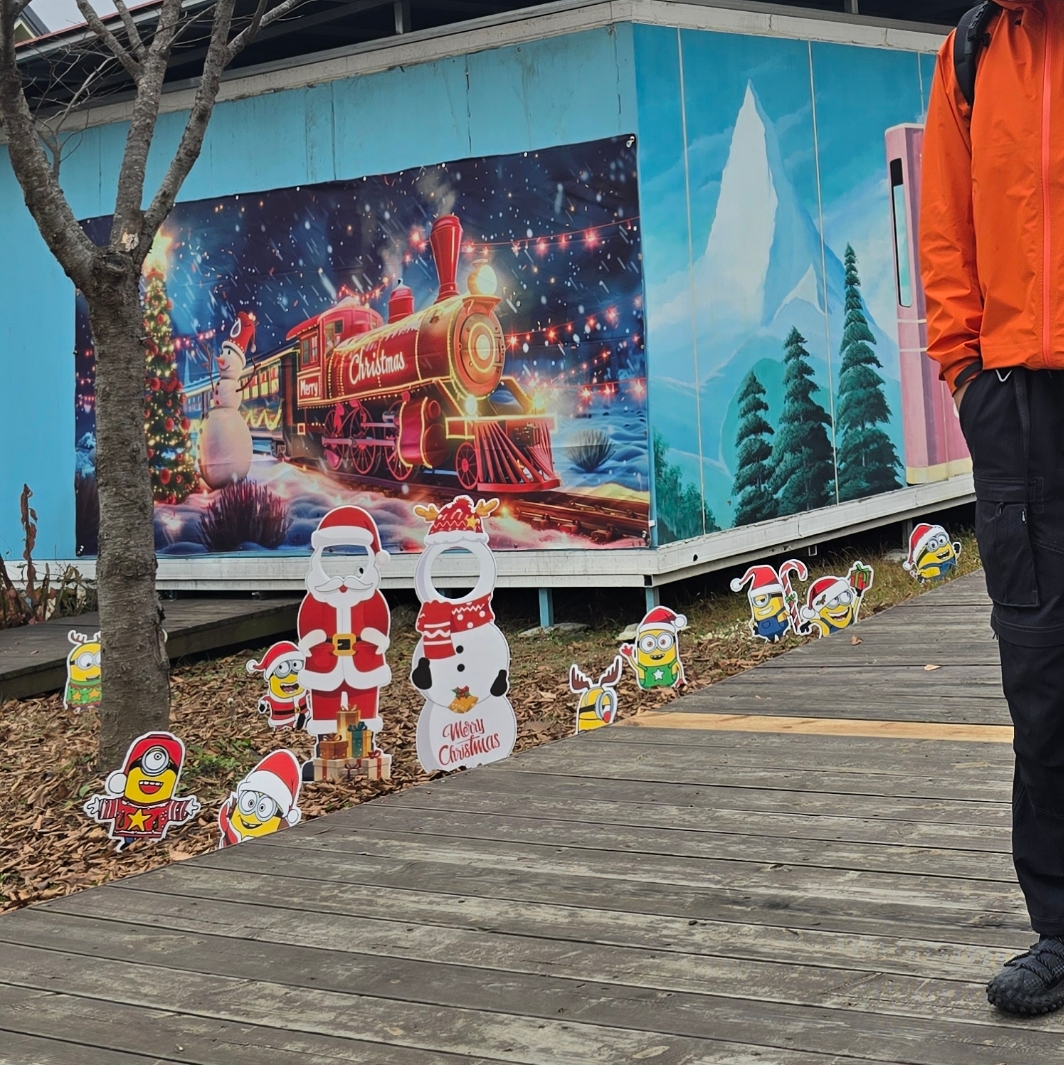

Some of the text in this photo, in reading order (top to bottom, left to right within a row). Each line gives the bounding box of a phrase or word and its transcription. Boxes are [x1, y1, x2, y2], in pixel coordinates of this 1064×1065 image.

[349, 346, 405, 385] Christmas
[300, 379, 318, 396] Merry
[442, 718, 485, 741] Merry
[438, 733, 501, 766] Christmas
